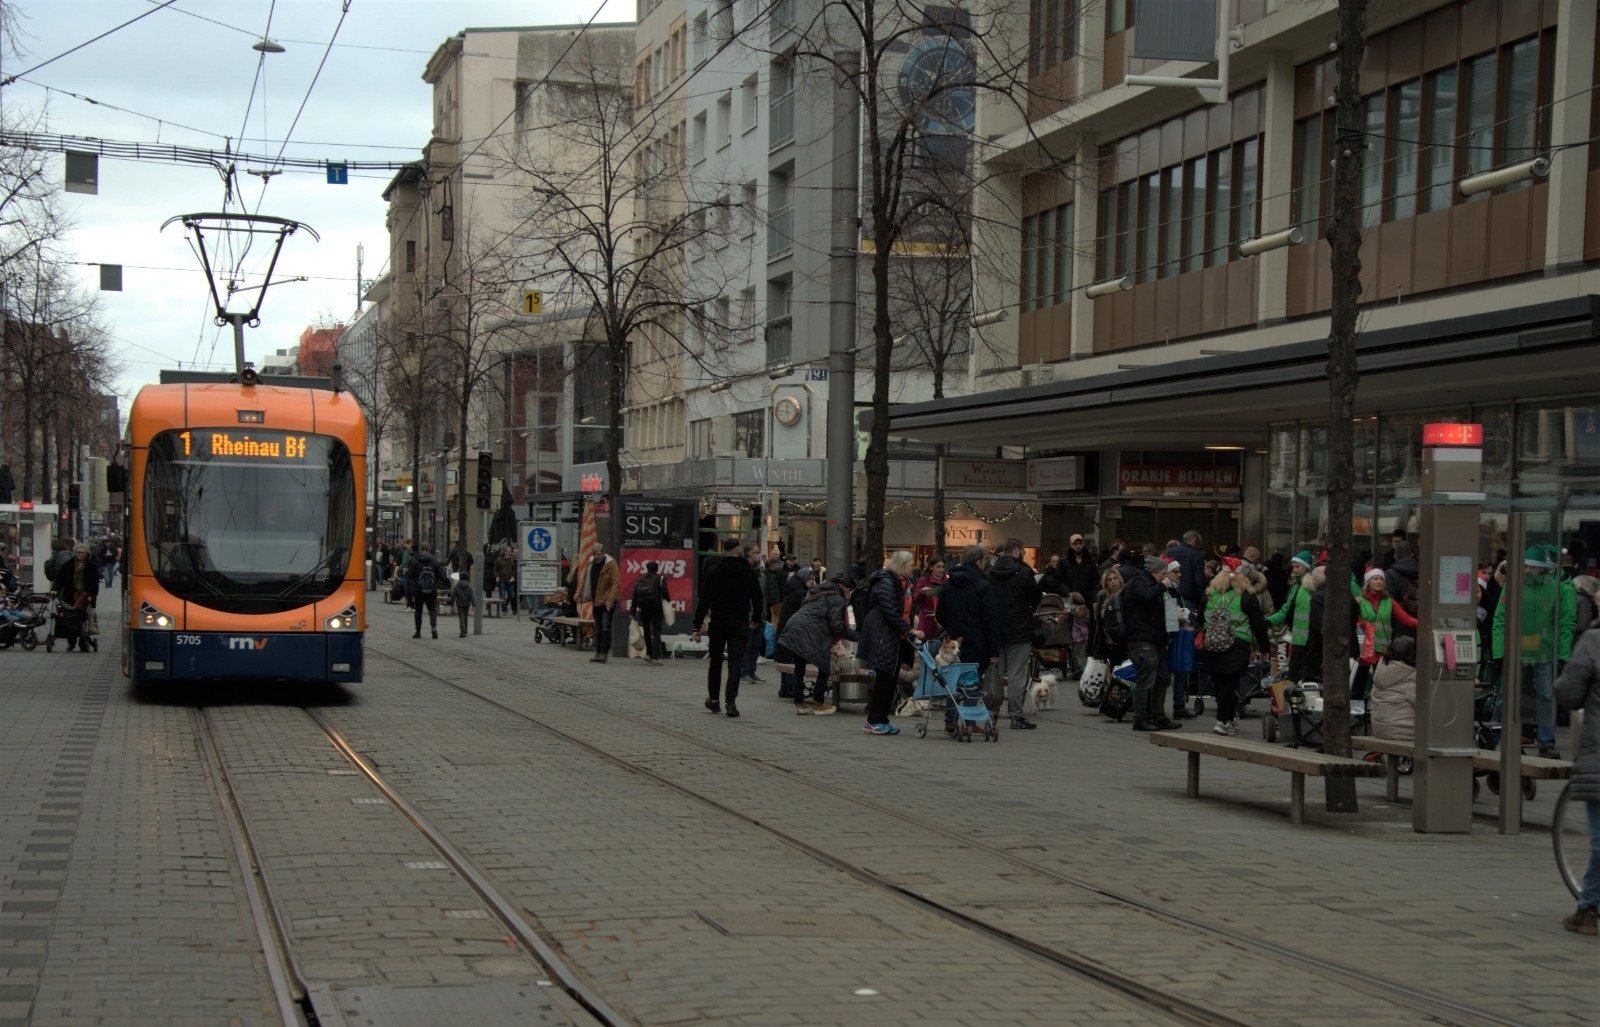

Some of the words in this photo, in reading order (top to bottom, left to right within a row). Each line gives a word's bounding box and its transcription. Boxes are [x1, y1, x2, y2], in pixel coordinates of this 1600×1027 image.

[178, 431, 192, 456] 1
[211, 433, 280, 457] Rheinau
[285, 436, 306, 458] Bf
[971, 463, 1006, 475] Wiener
[1121, 469, 1172, 483] ORANJE
[1178, 470, 1233, 484] BLUMEN
[962, 474, 1012, 486] Feinbäcker
[625, 516, 668, 535] SISI
[176, 635, 202, 646] 5705
[229, 636, 269, 650] rnv
